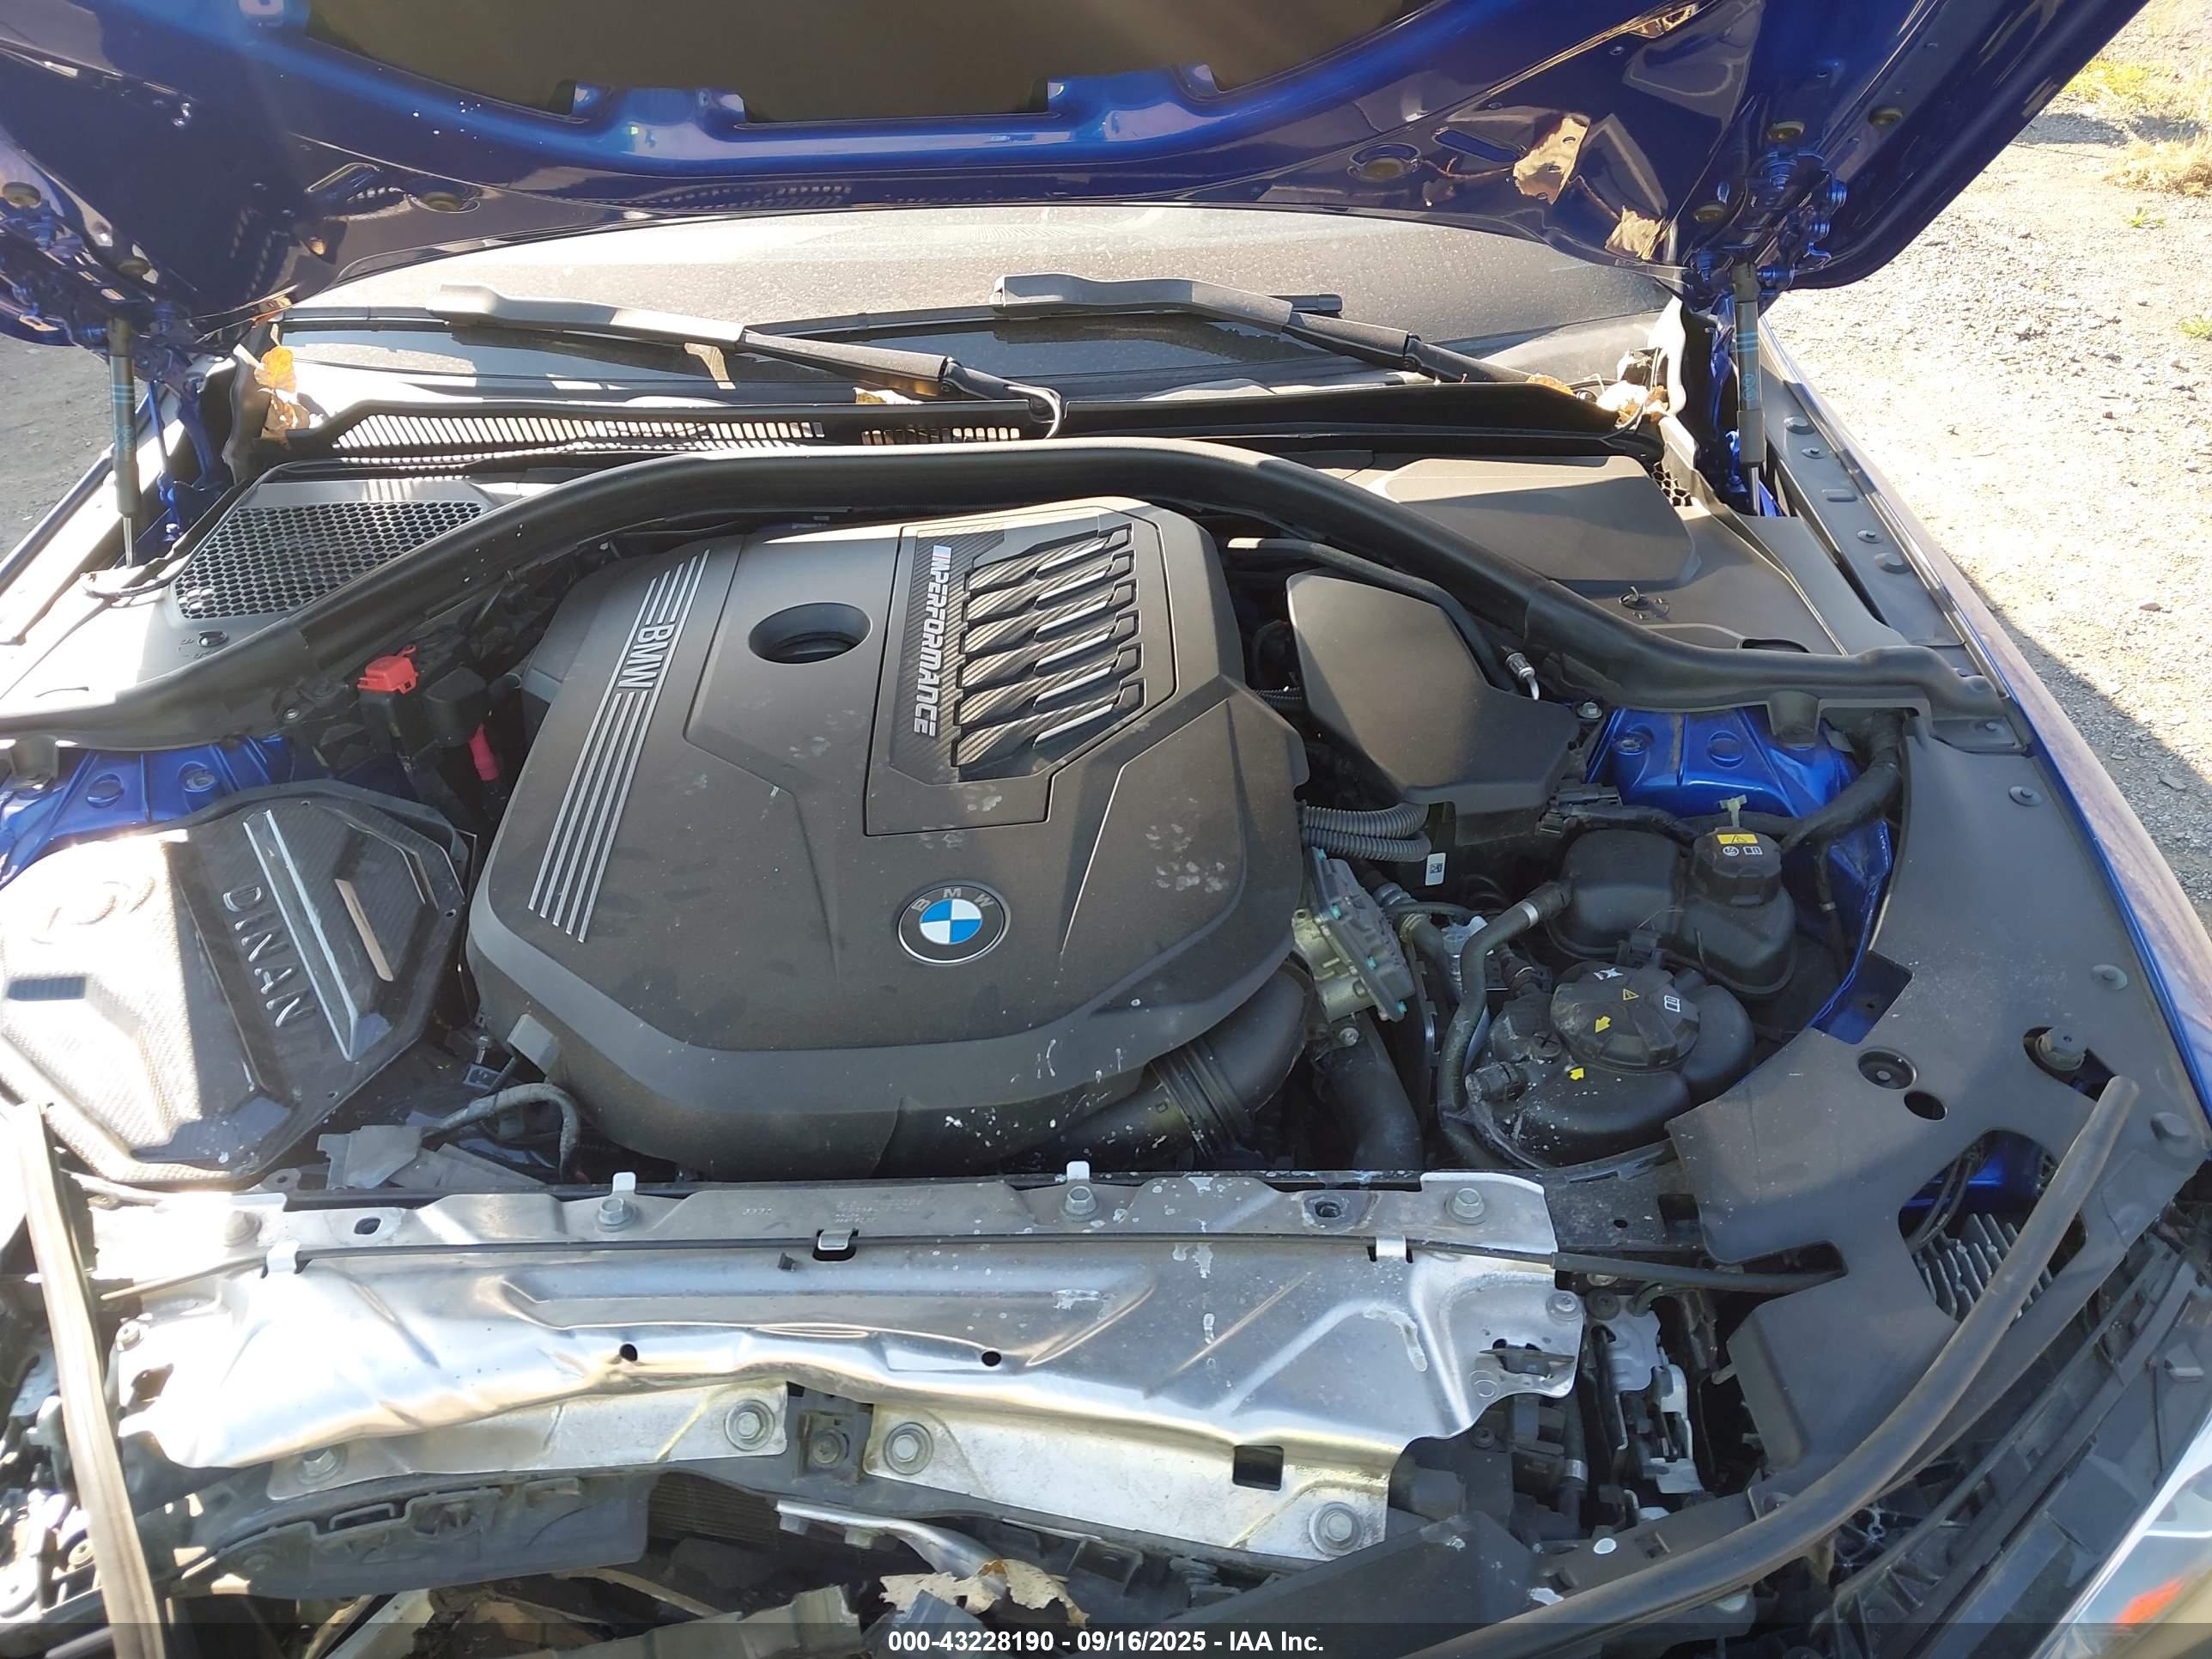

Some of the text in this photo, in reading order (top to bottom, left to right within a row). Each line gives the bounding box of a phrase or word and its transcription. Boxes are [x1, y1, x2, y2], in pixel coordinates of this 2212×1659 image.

[617, 624, 676, 688] BMW
[913, 569, 949, 737] PERFORMANCE
[910, 888, 995, 912] BMW
[222, 884, 317, 1028] DINAN
